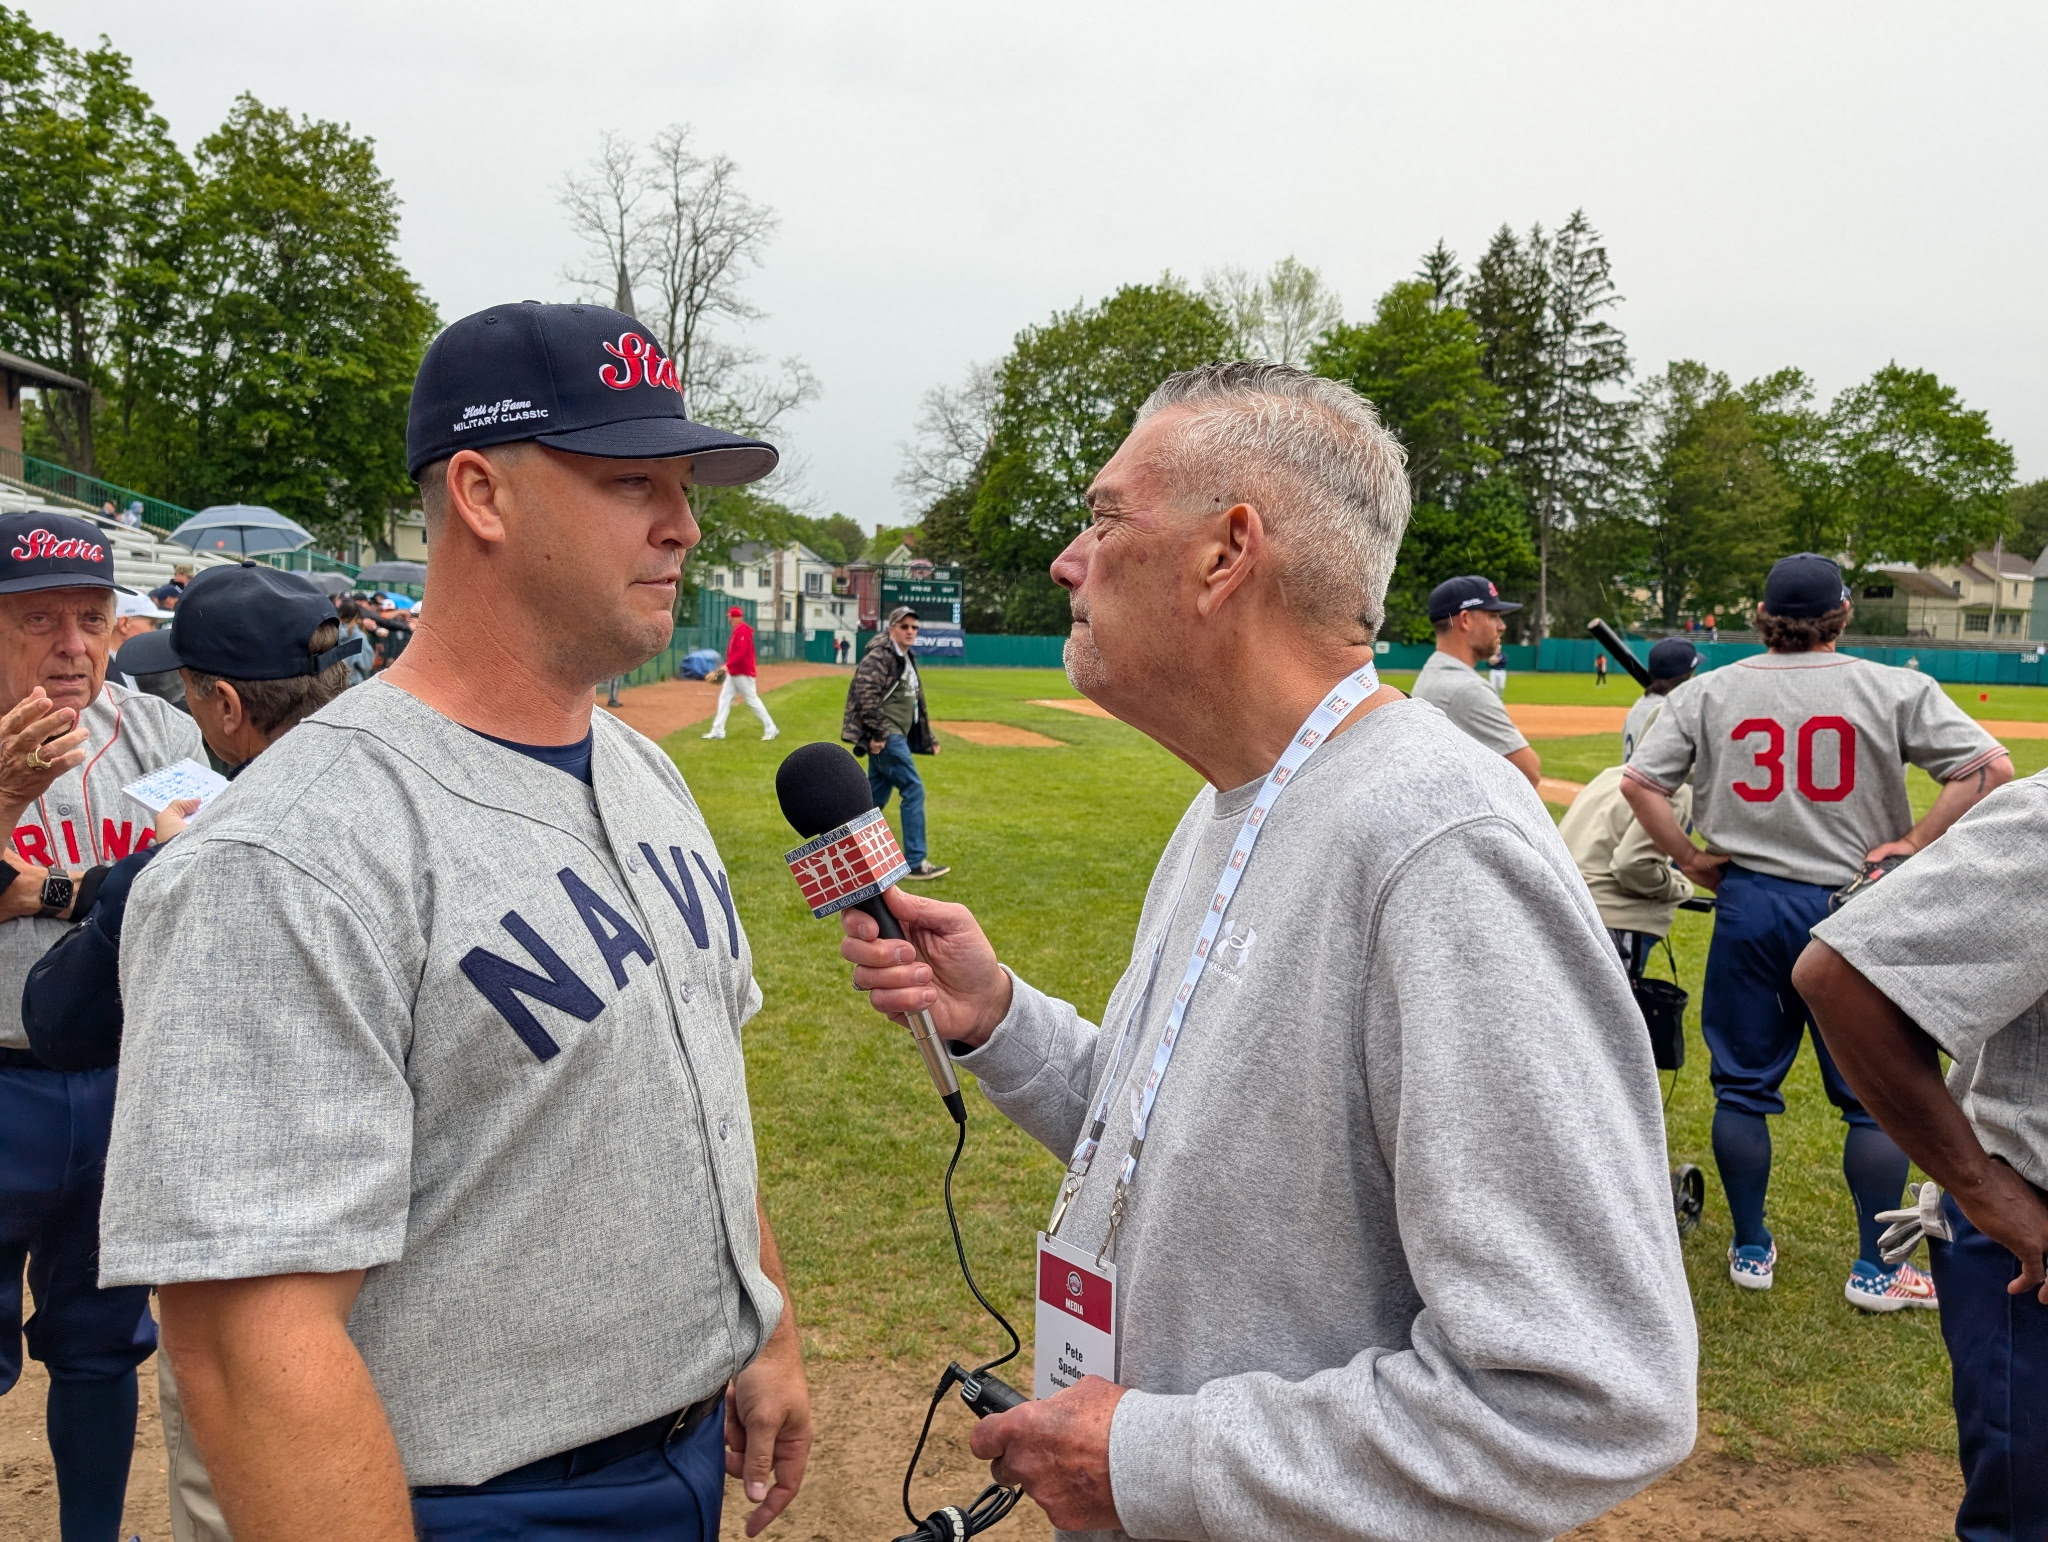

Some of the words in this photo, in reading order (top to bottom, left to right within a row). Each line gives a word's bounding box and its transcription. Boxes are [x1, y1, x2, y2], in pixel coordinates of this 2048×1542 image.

[599, 332, 685, 399] Sta
[453, 415, 498, 432] MILITARY
[501, 409, 549, 422] CLASSIC
[462, 405, 487, 420] Hall
[488, 401, 501, 416] of
[501, 399, 531, 412] Fame
[11, 529, 104, 563] Stars
[914, 636, 937, 647] EW
[1730, 716, 1855, 802] 30
[786, 842, 814, 862] SPADORA
[813, 836, 827, 850] ON
[823, 824, 851, 845] SPORTS
[819, 901, 840, 917] SPORTS
[838, 892, 858, 908] MEDIA
[856, 885, 875, 901] GROUP
[459, 842, 739, 1063] NAVY
[1065, 1298, 1084, 1316] MEDIA
[1065, 1342, 1084, 1363] Pete
